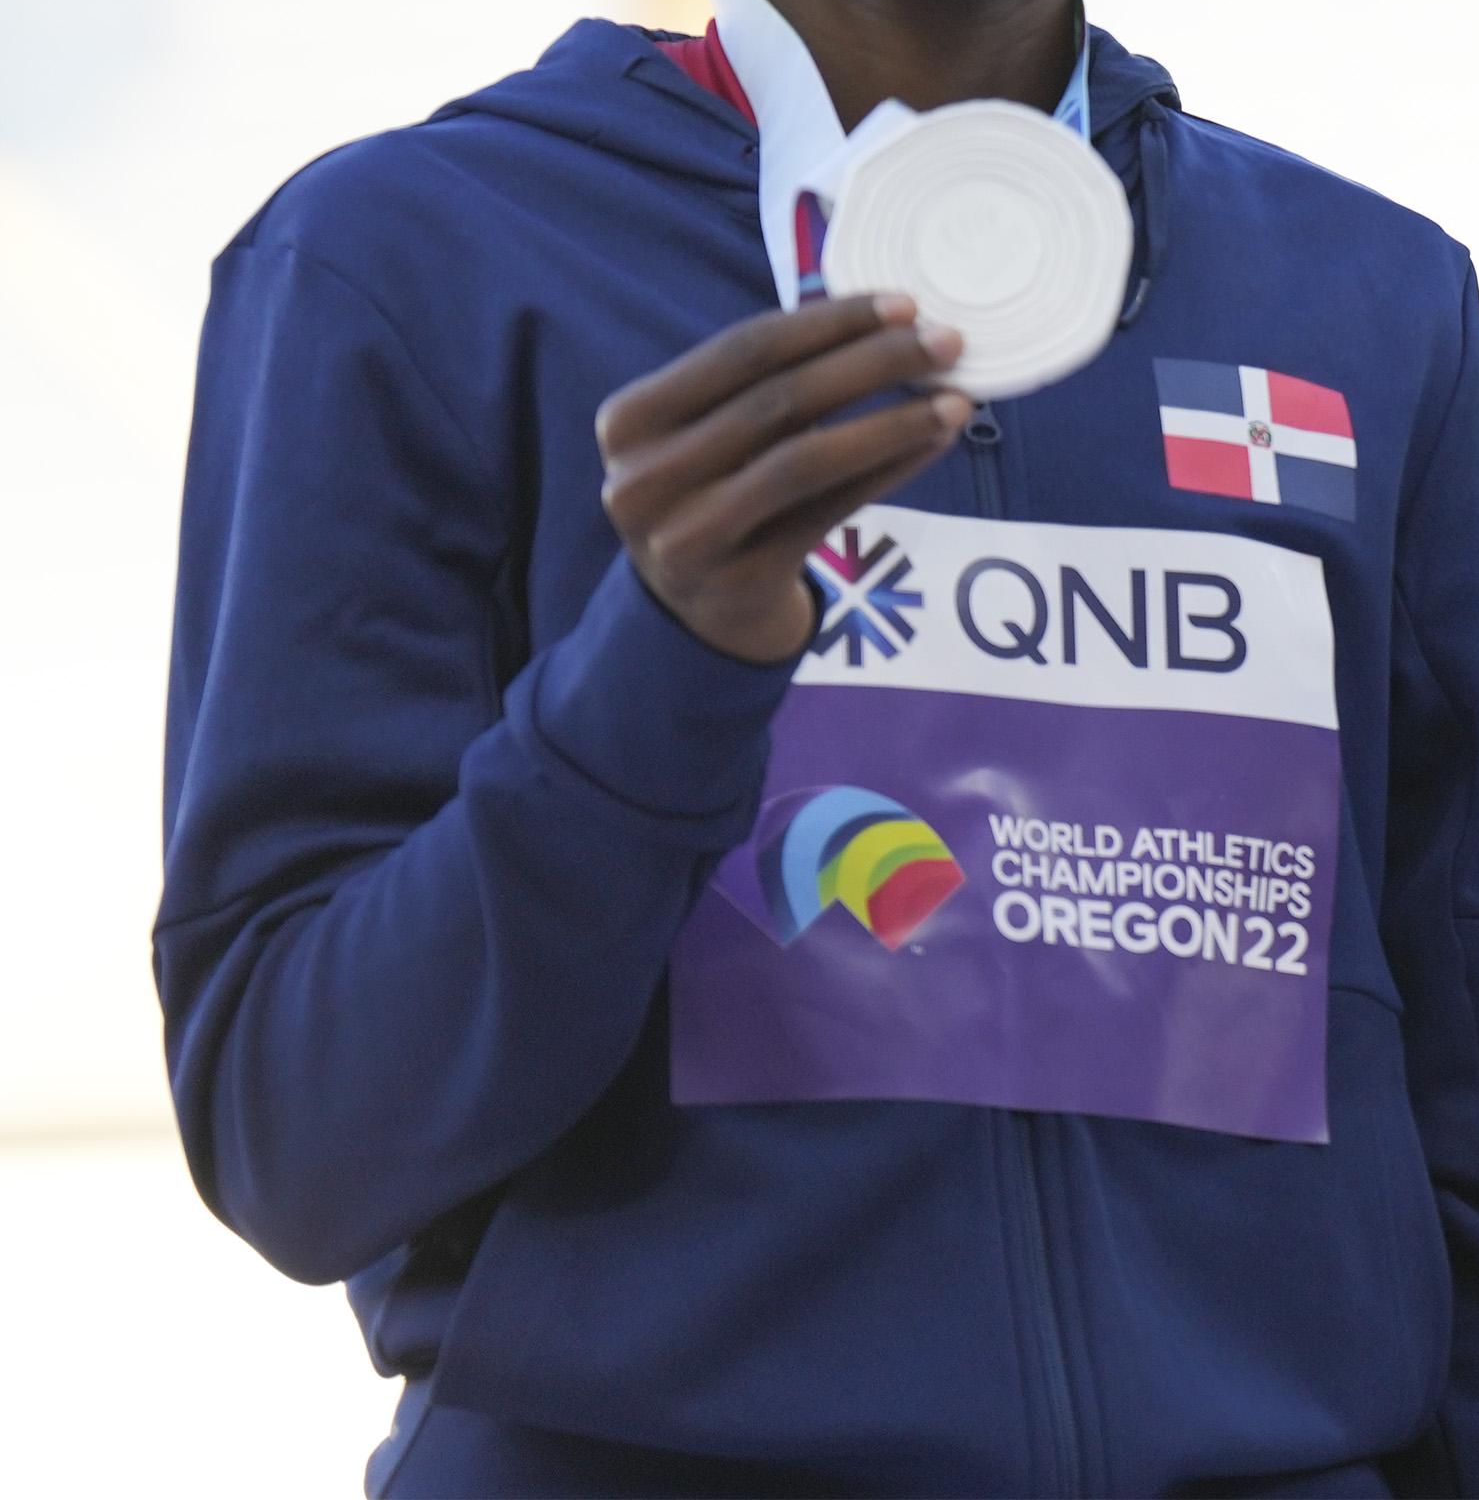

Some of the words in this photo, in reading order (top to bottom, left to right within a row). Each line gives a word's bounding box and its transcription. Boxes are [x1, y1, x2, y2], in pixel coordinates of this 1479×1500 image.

[956, 557, 1248, 673] QNB
[988, 813, 1123, 859] WORLD
[1131, 827, 1315, 880] ATHLETICS
[991, 849, 1312, 919] CHAMPIONSHIPS
